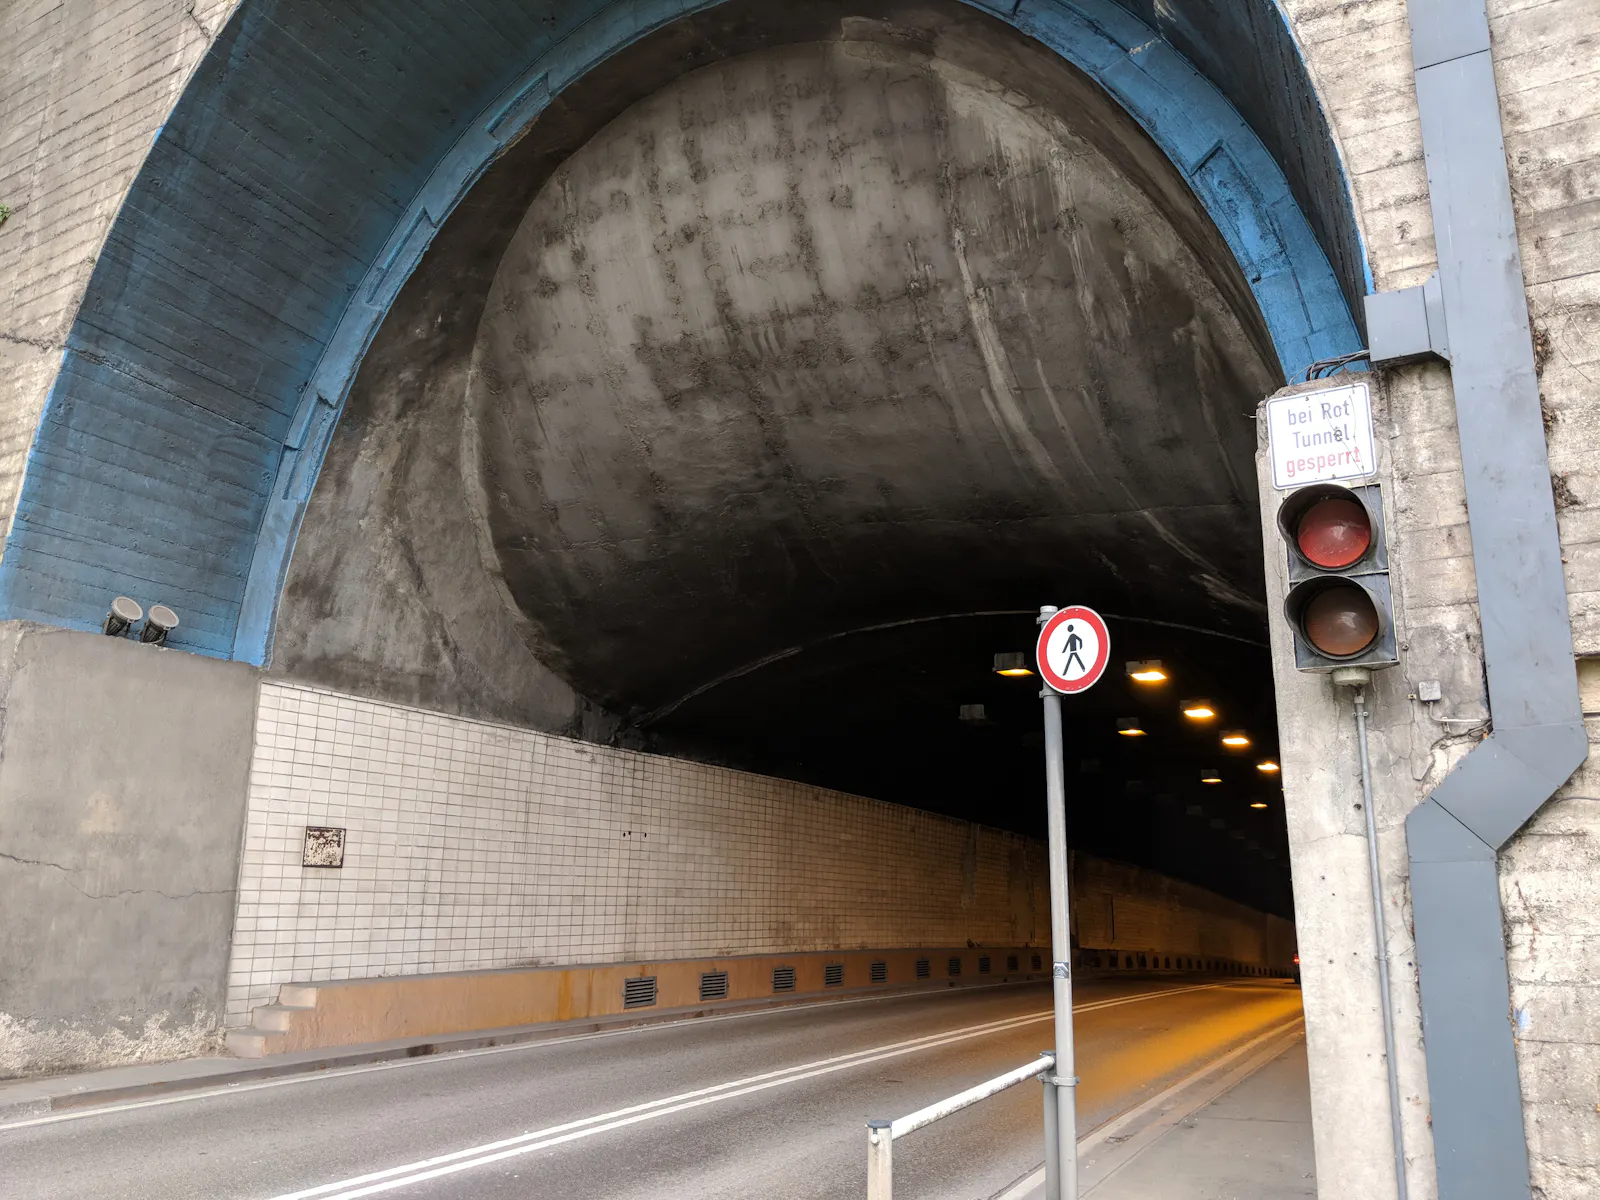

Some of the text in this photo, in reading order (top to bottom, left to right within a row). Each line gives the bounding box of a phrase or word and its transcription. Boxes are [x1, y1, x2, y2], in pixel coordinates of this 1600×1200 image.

[1288, 400, 1350, 426] bei Rot
[1293, 424, 1350, 449] Tunnel
[1286, 446, 1361, 478] gesperrt
